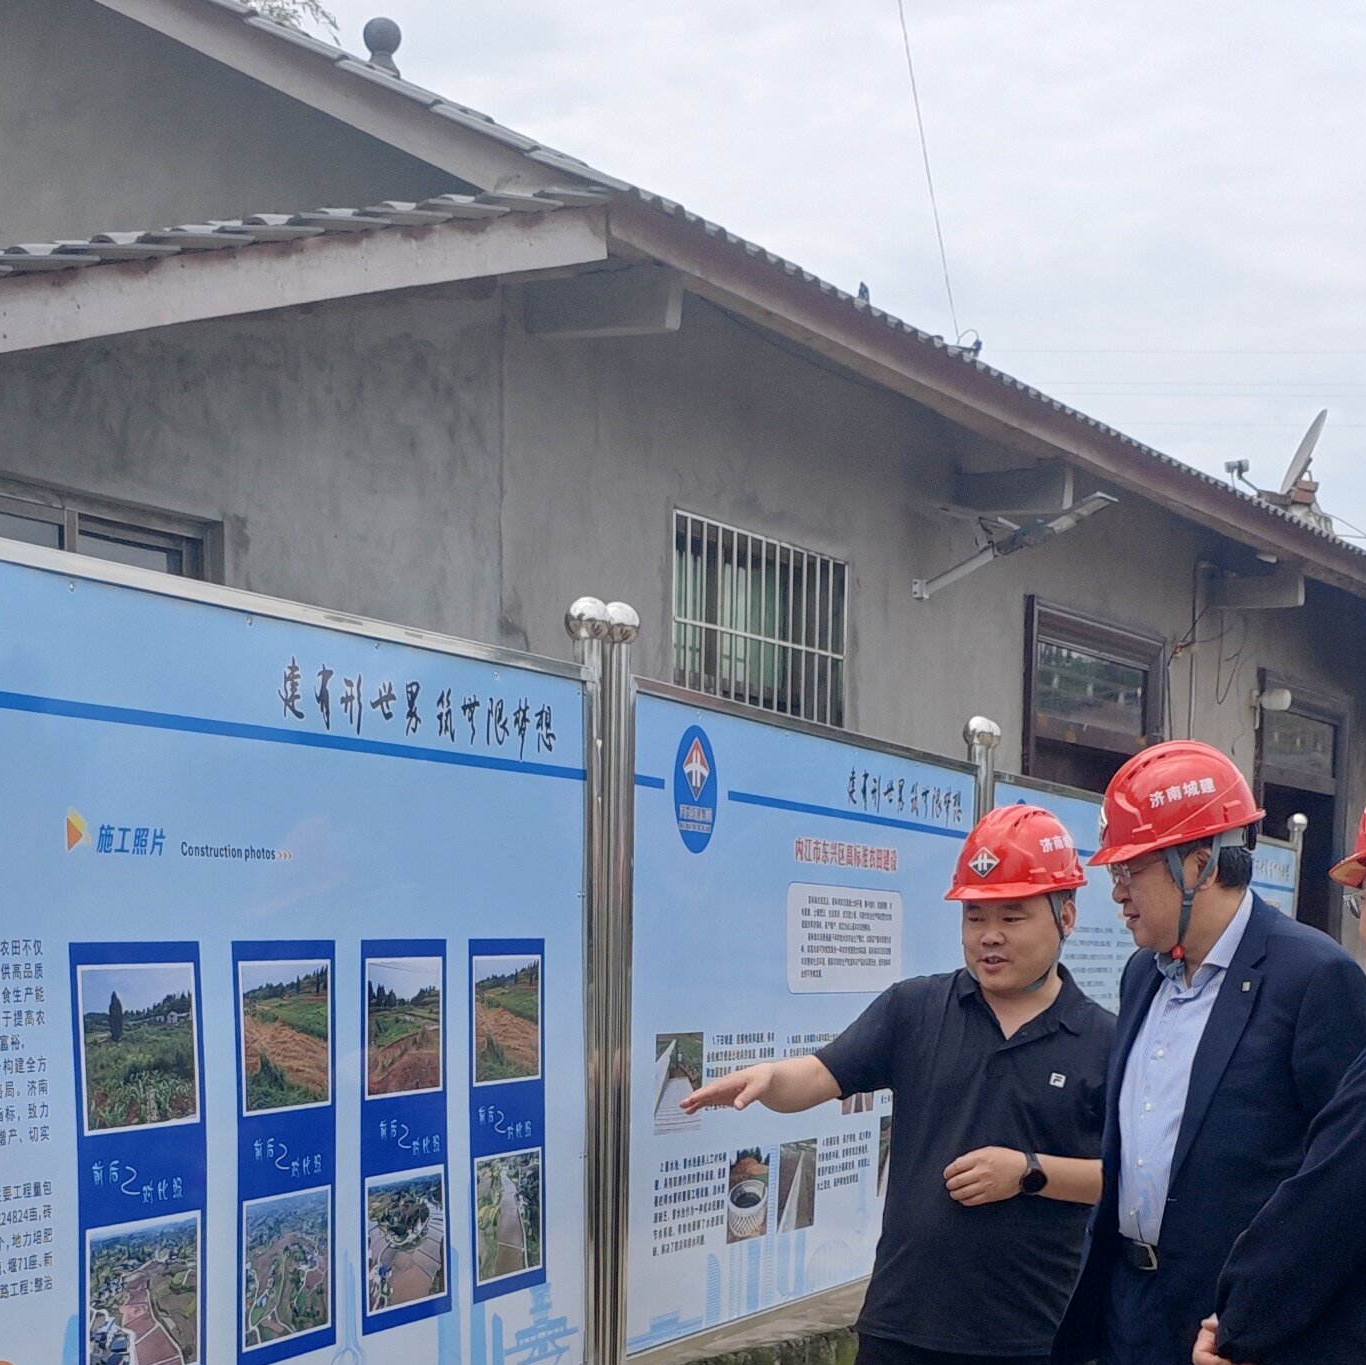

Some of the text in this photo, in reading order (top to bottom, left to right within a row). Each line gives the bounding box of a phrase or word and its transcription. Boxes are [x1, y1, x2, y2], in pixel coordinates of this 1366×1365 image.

[1149, 777, 1217, 809] 济南城建
[96, 823, 167, 857] 施工照片
[180, 841, 277, 862] Construction photos
